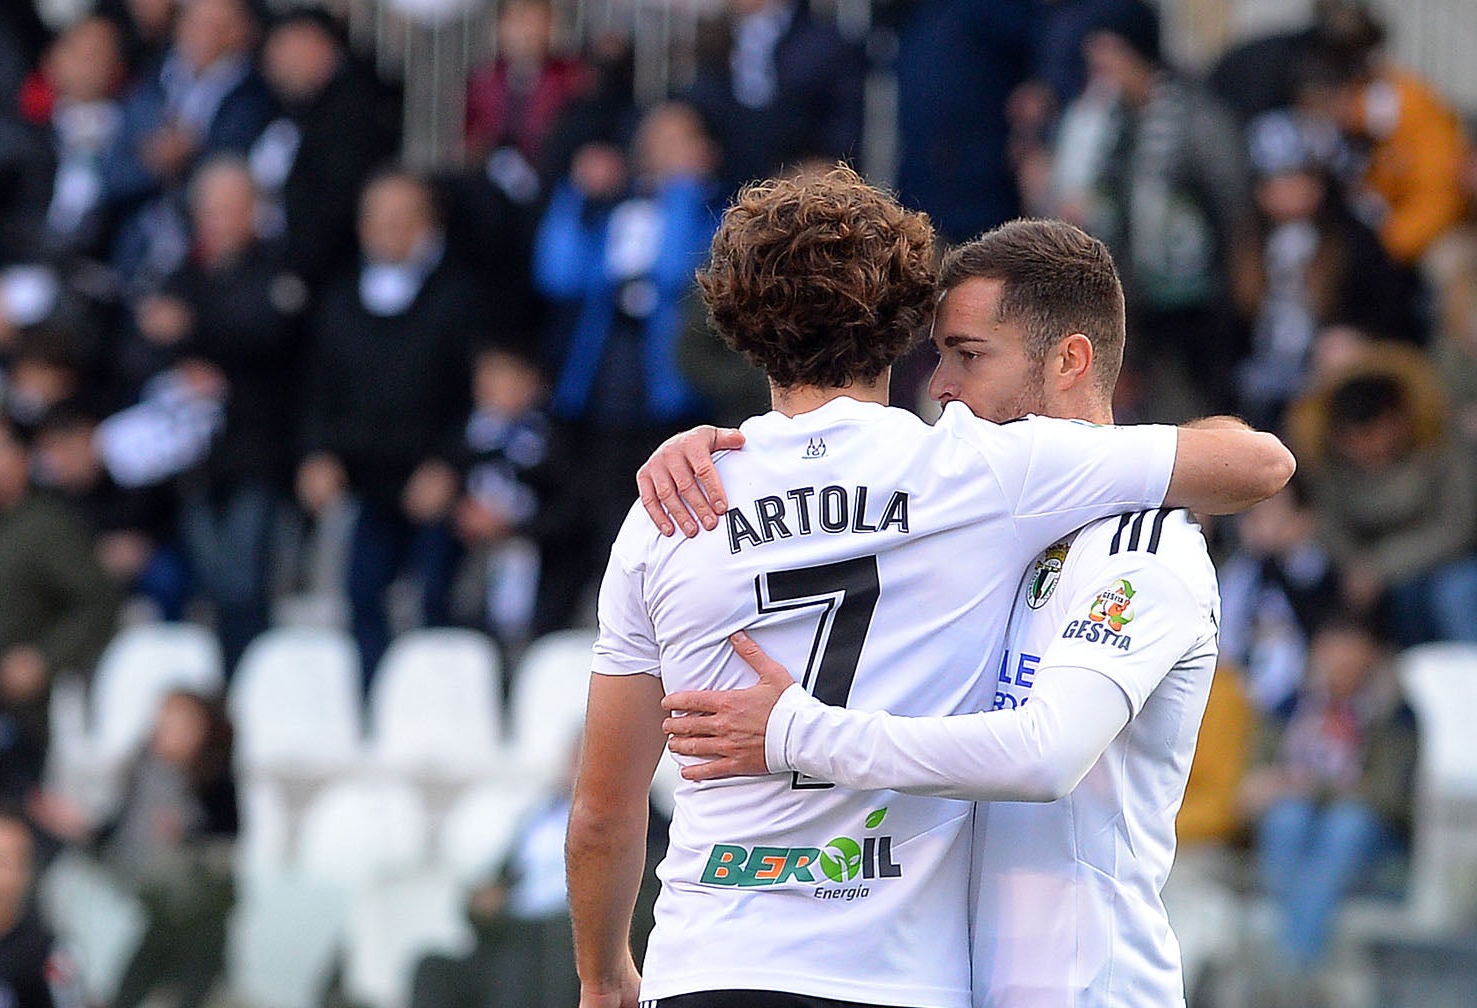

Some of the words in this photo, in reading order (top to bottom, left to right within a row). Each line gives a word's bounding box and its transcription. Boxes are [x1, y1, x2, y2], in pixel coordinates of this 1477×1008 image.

[726, 485, 910, 554] ARTOLA
[755, 554, 881, 790] 7
[700, 836, 902, 887] BEROIL
[814, 883, 870, 901] Energía
